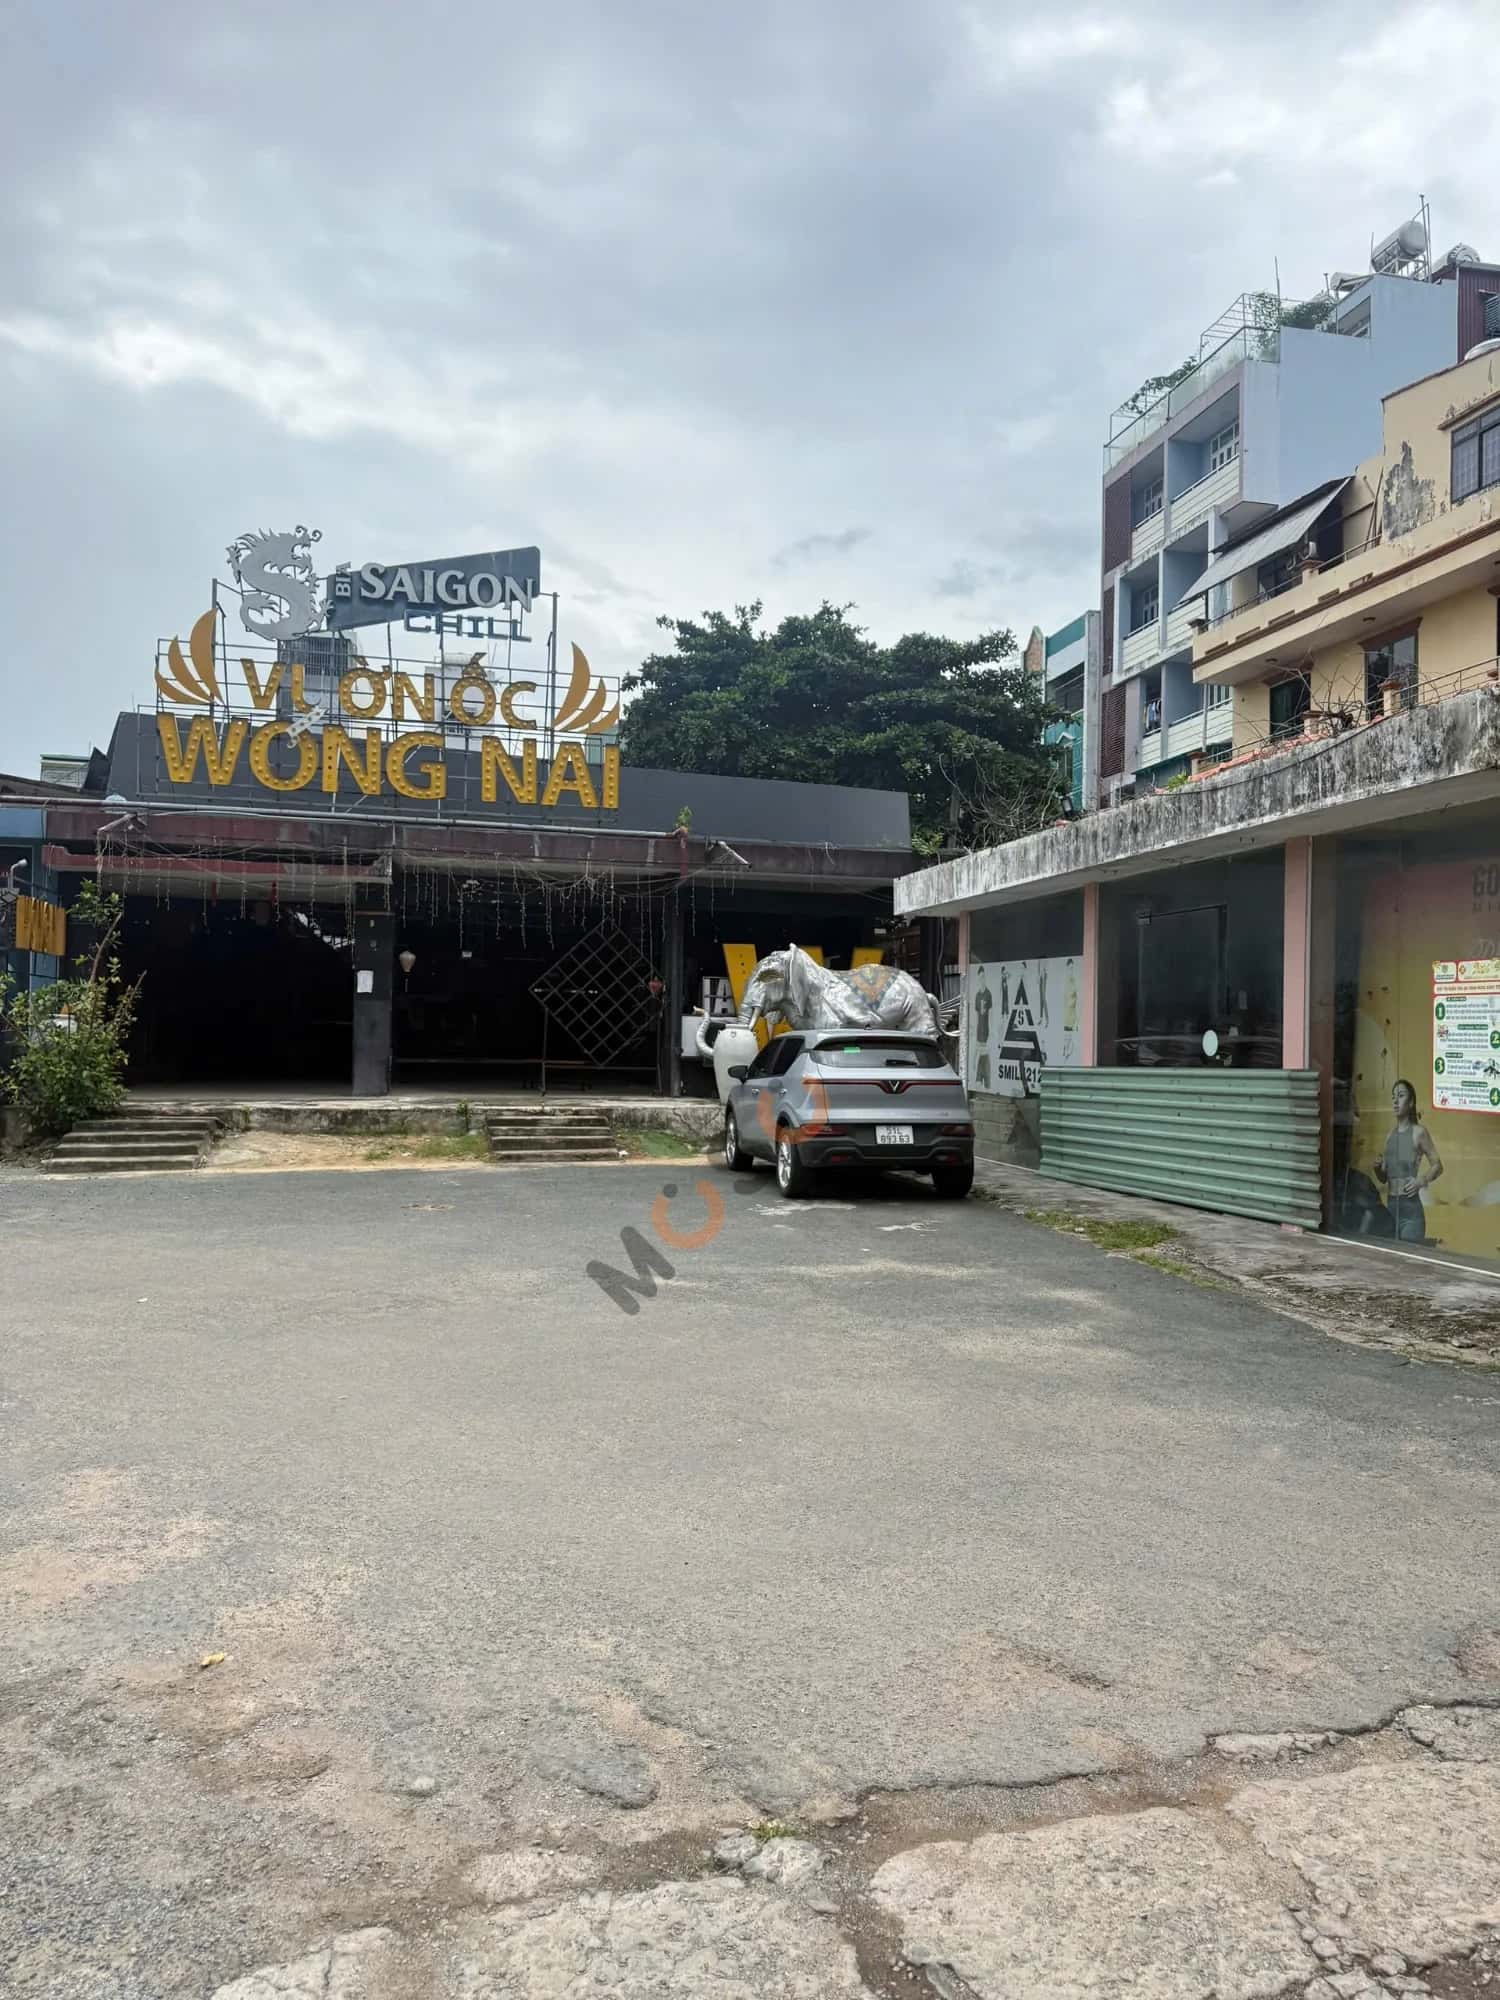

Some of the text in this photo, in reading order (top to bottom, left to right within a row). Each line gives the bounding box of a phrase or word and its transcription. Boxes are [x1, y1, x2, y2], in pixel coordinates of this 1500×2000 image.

[336, 561, 351, 597] BIA
[360, 562, 534, 613] SAIGON
[404, 608, 532, 642] CHILL
[450, 652, 537, 730] ỐC
[157, 712, 619, 809] WONG NAI
